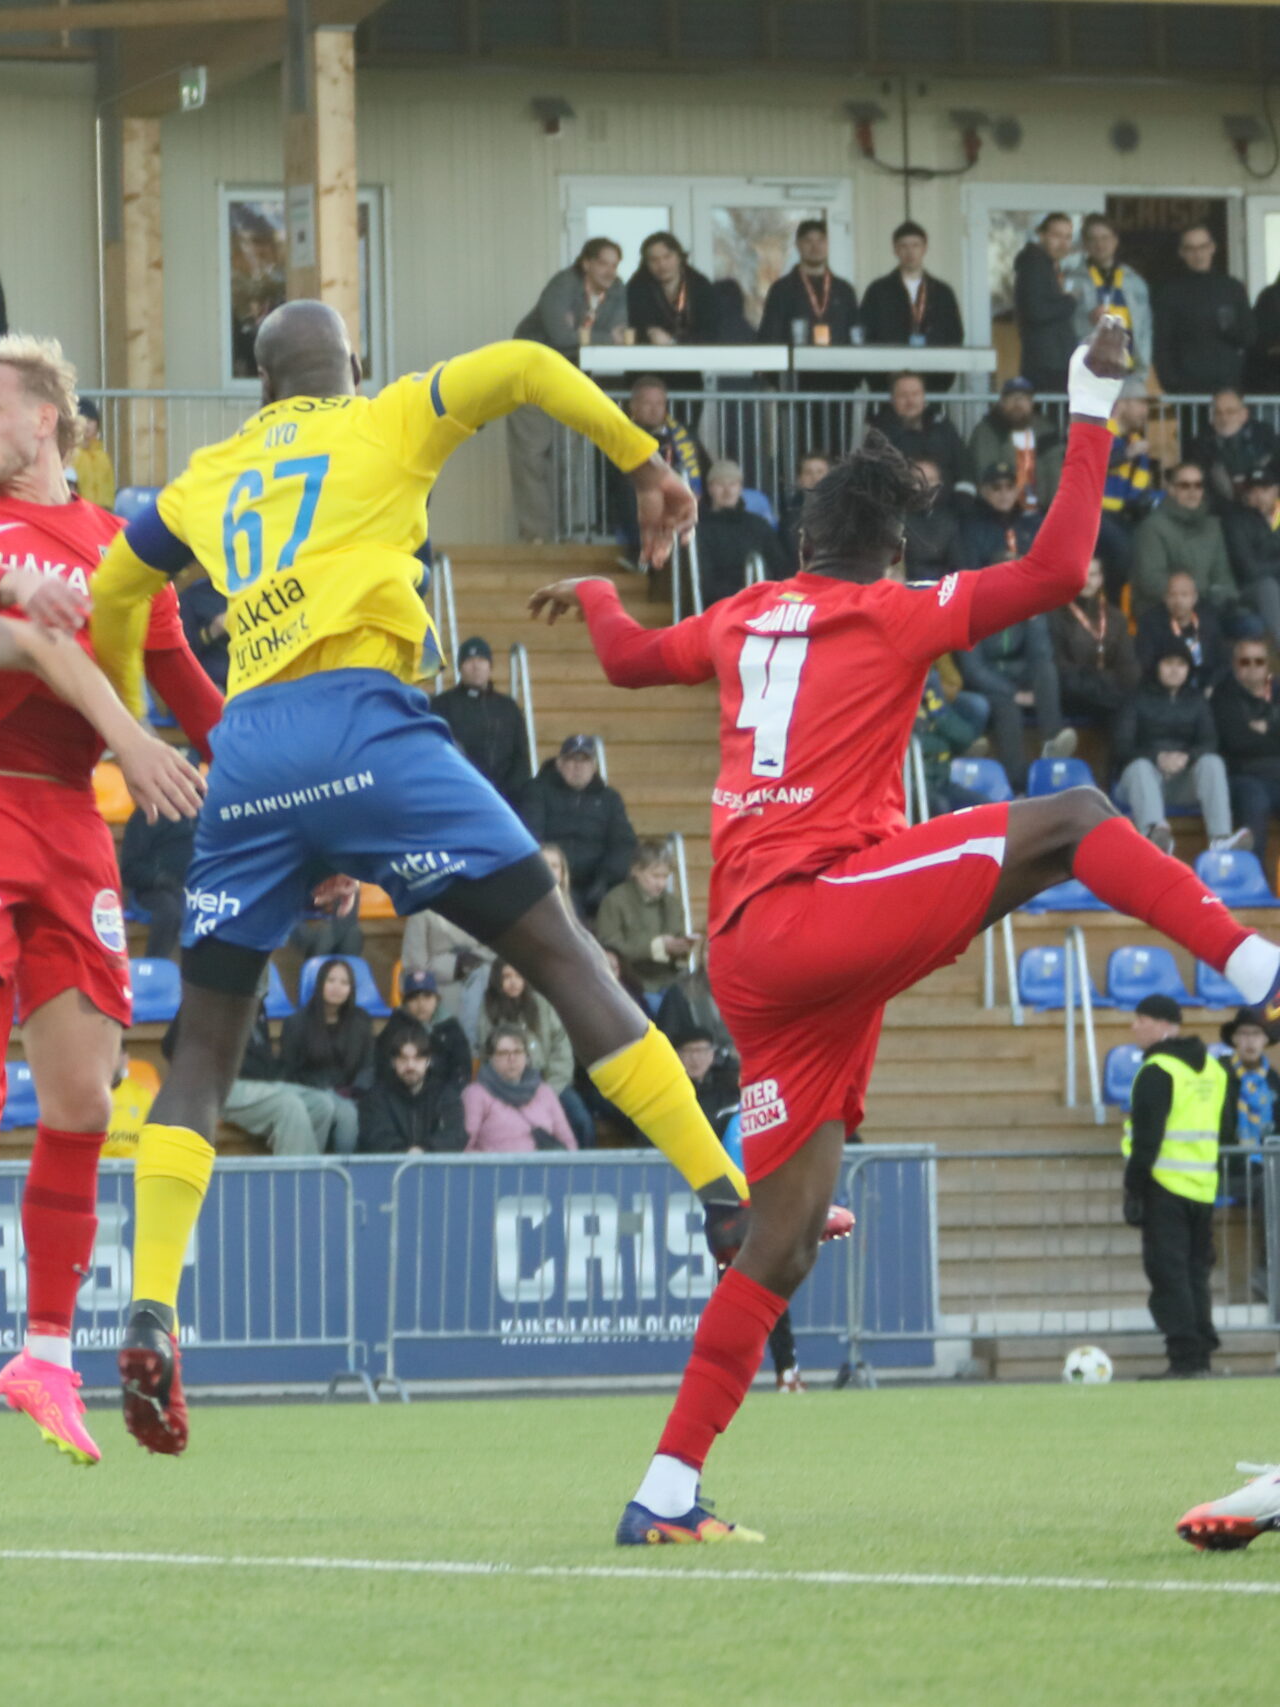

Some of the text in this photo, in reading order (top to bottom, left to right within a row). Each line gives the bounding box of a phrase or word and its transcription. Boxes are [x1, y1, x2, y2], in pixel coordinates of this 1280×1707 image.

[223, 454, 330, 593] 67
[736, 634, 810, 778] 4
[220, 770, 375, 821] #PAINUHIITEEN
[495, 1192, 718, 1303] CRIS
